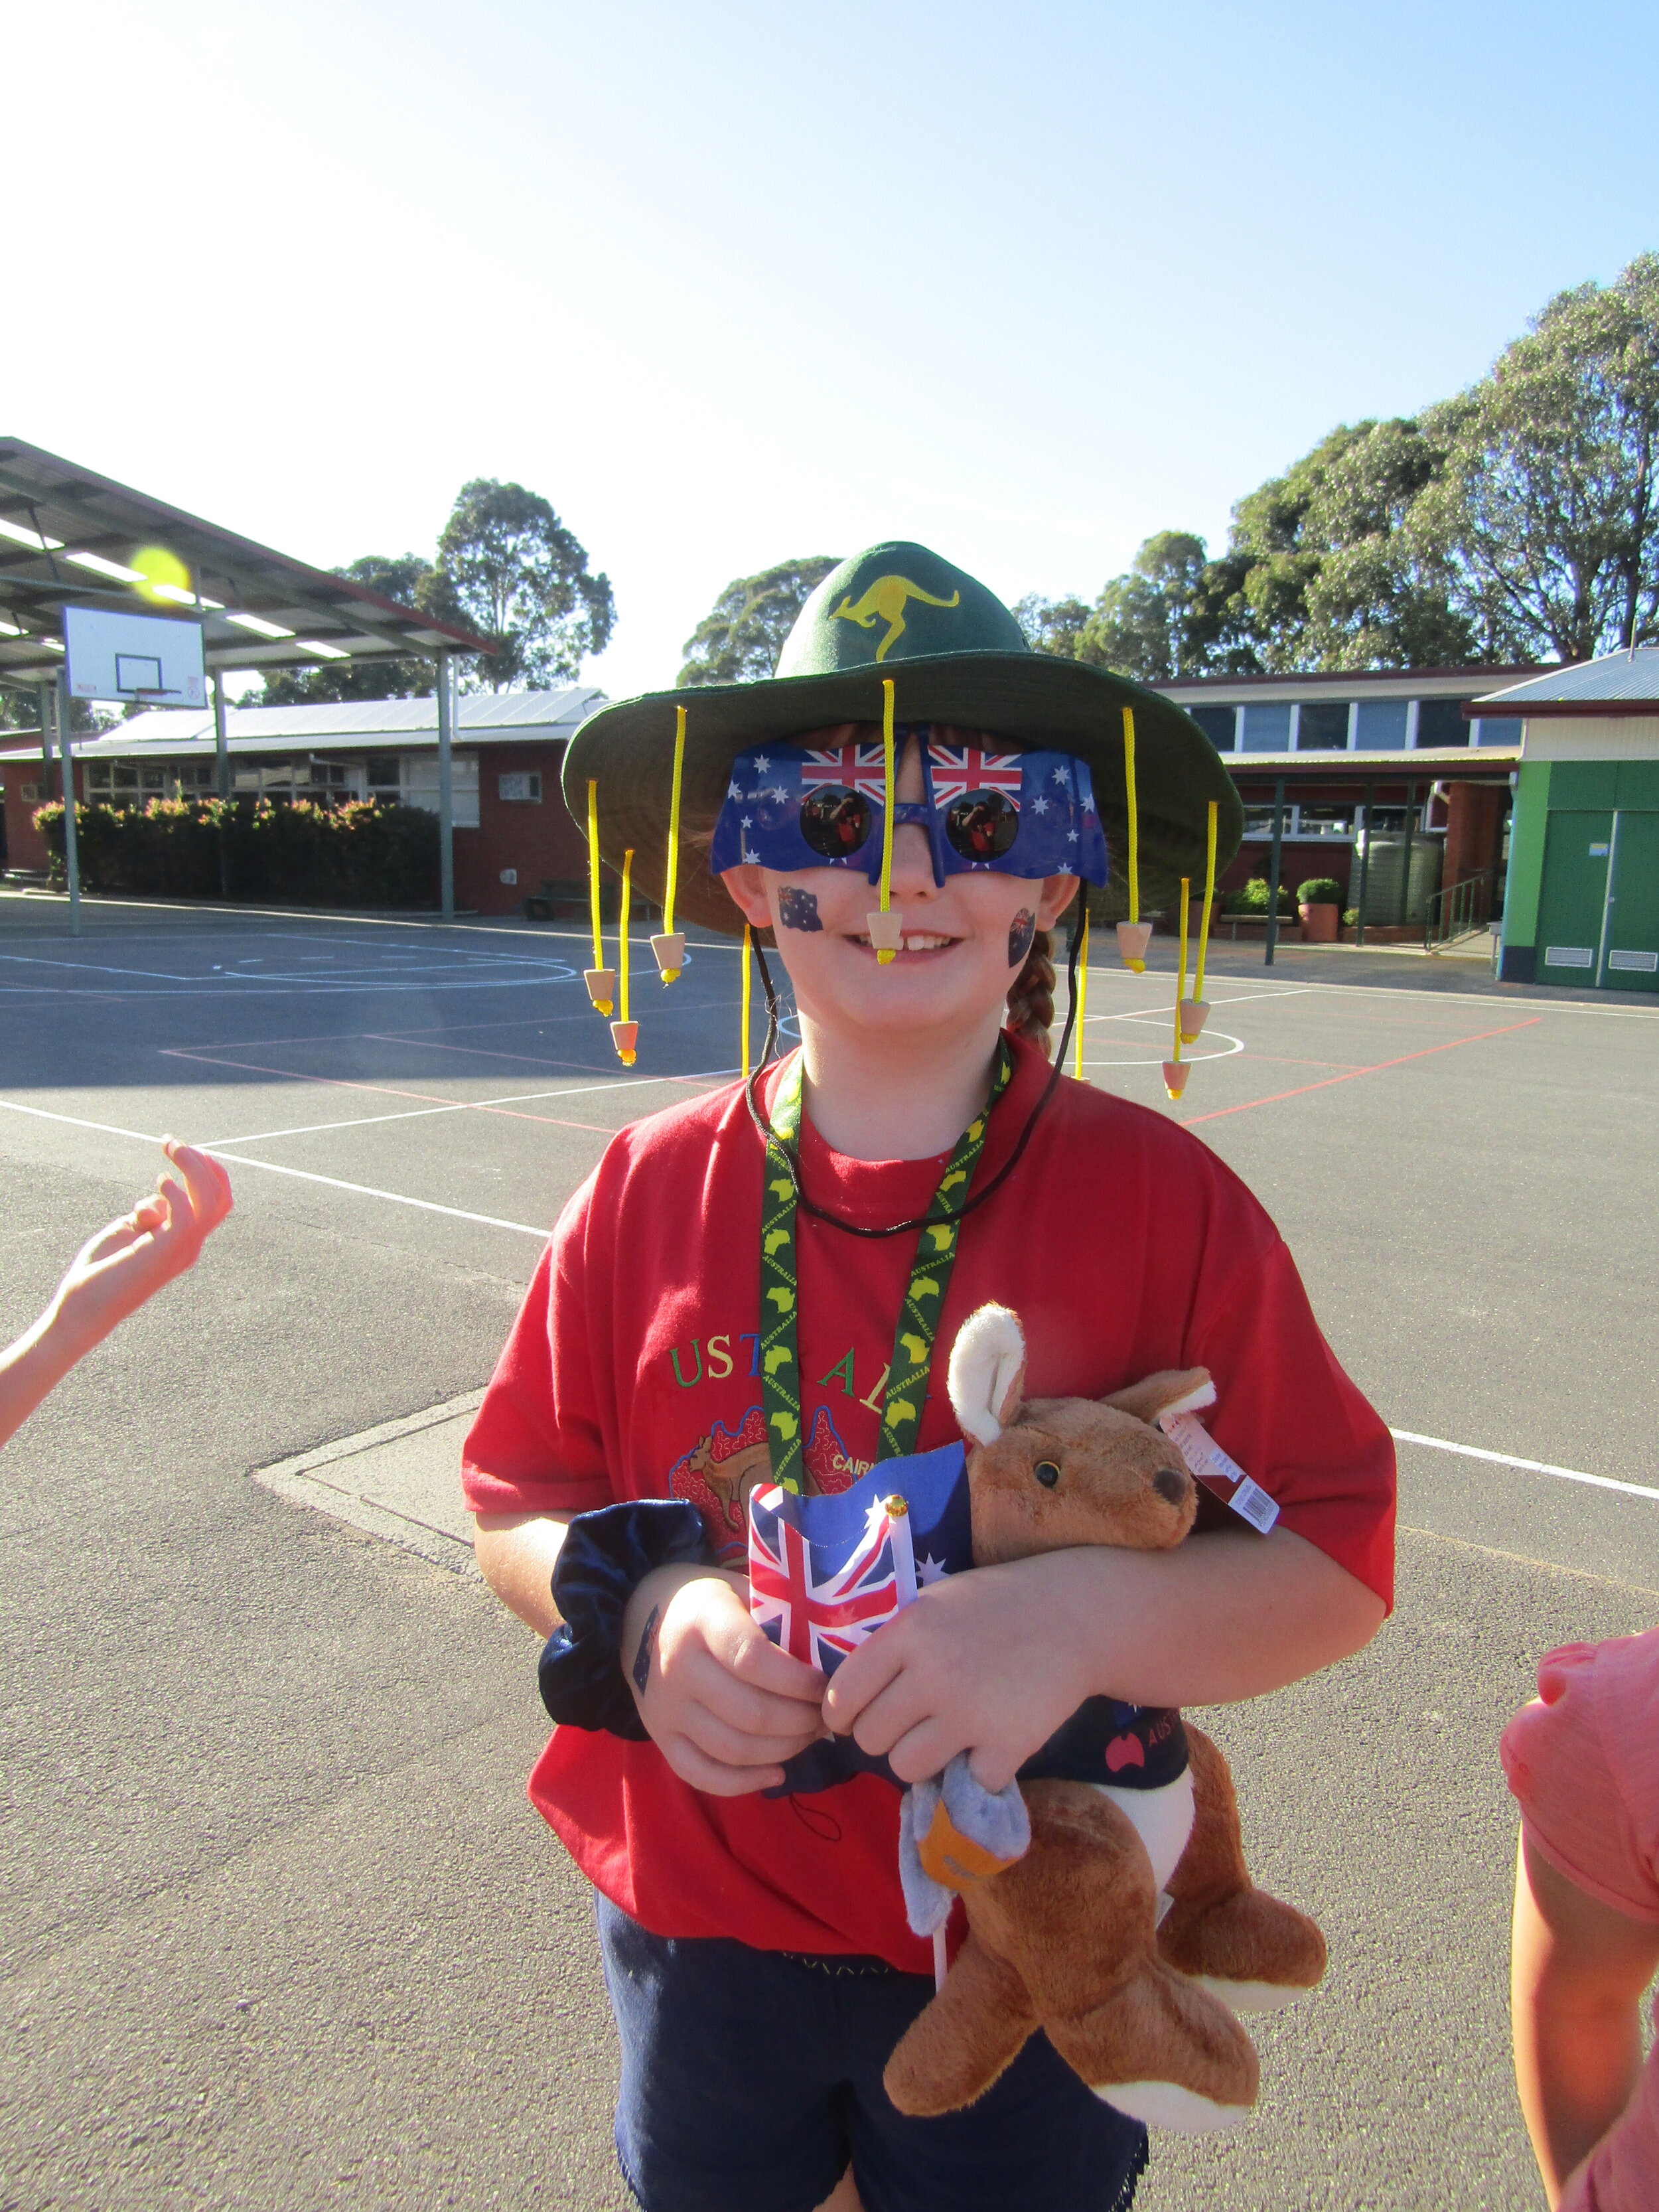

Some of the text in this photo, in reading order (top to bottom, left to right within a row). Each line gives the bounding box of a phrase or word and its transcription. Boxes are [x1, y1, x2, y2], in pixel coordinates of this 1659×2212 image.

[946, 1140, 984, 1173] AUSTRALIA
[761, 1199, 798, 1234] AUSTRALIA
[762, 1255, 798, 1286] AUSTRALIA
[910, 1251, 956, 1277] AUSTRALIA
[760, 1310, 798, 1351] AUSTRALIA
[904, 1297, 936, 1341] AUSTRALIA
[763, 1374, 800, 1412] AUSTRALIA
[885, 1365, 930, 1400] AUSTRALIA
[774, 1438, 802, 1483] AUSTRALIA
